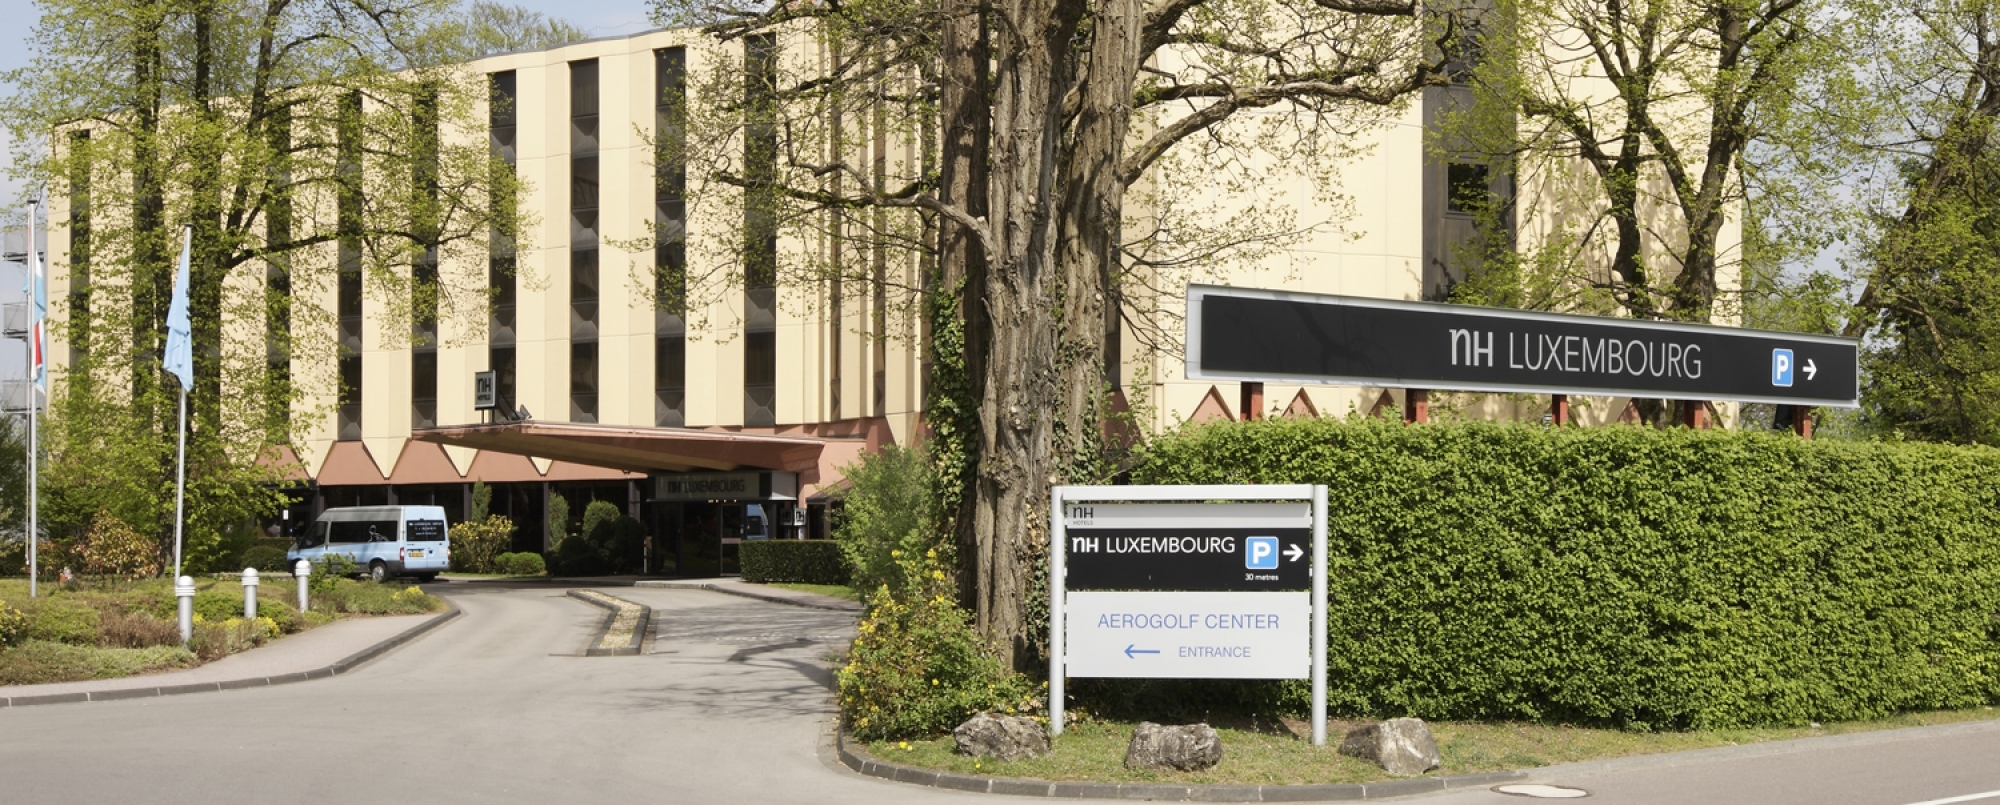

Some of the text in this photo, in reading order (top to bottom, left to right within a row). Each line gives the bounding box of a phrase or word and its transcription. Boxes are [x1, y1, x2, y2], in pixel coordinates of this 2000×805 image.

[1509, 332, 1702, 379] LUXEMBOURG
[1776, 354, 1789, 380] P
[684, 479, 745, 493] LUXEMBOURG
[1106, 536, 1235, 553] LUXEMBOURG
[1252, 541, 1272, 565] P
[1245, 573, 1254, 581] 30
[1097, 613, 1280, 629] AEROGOLF CENTER
[1178, 646, 1251, 658] ENTRANCE
